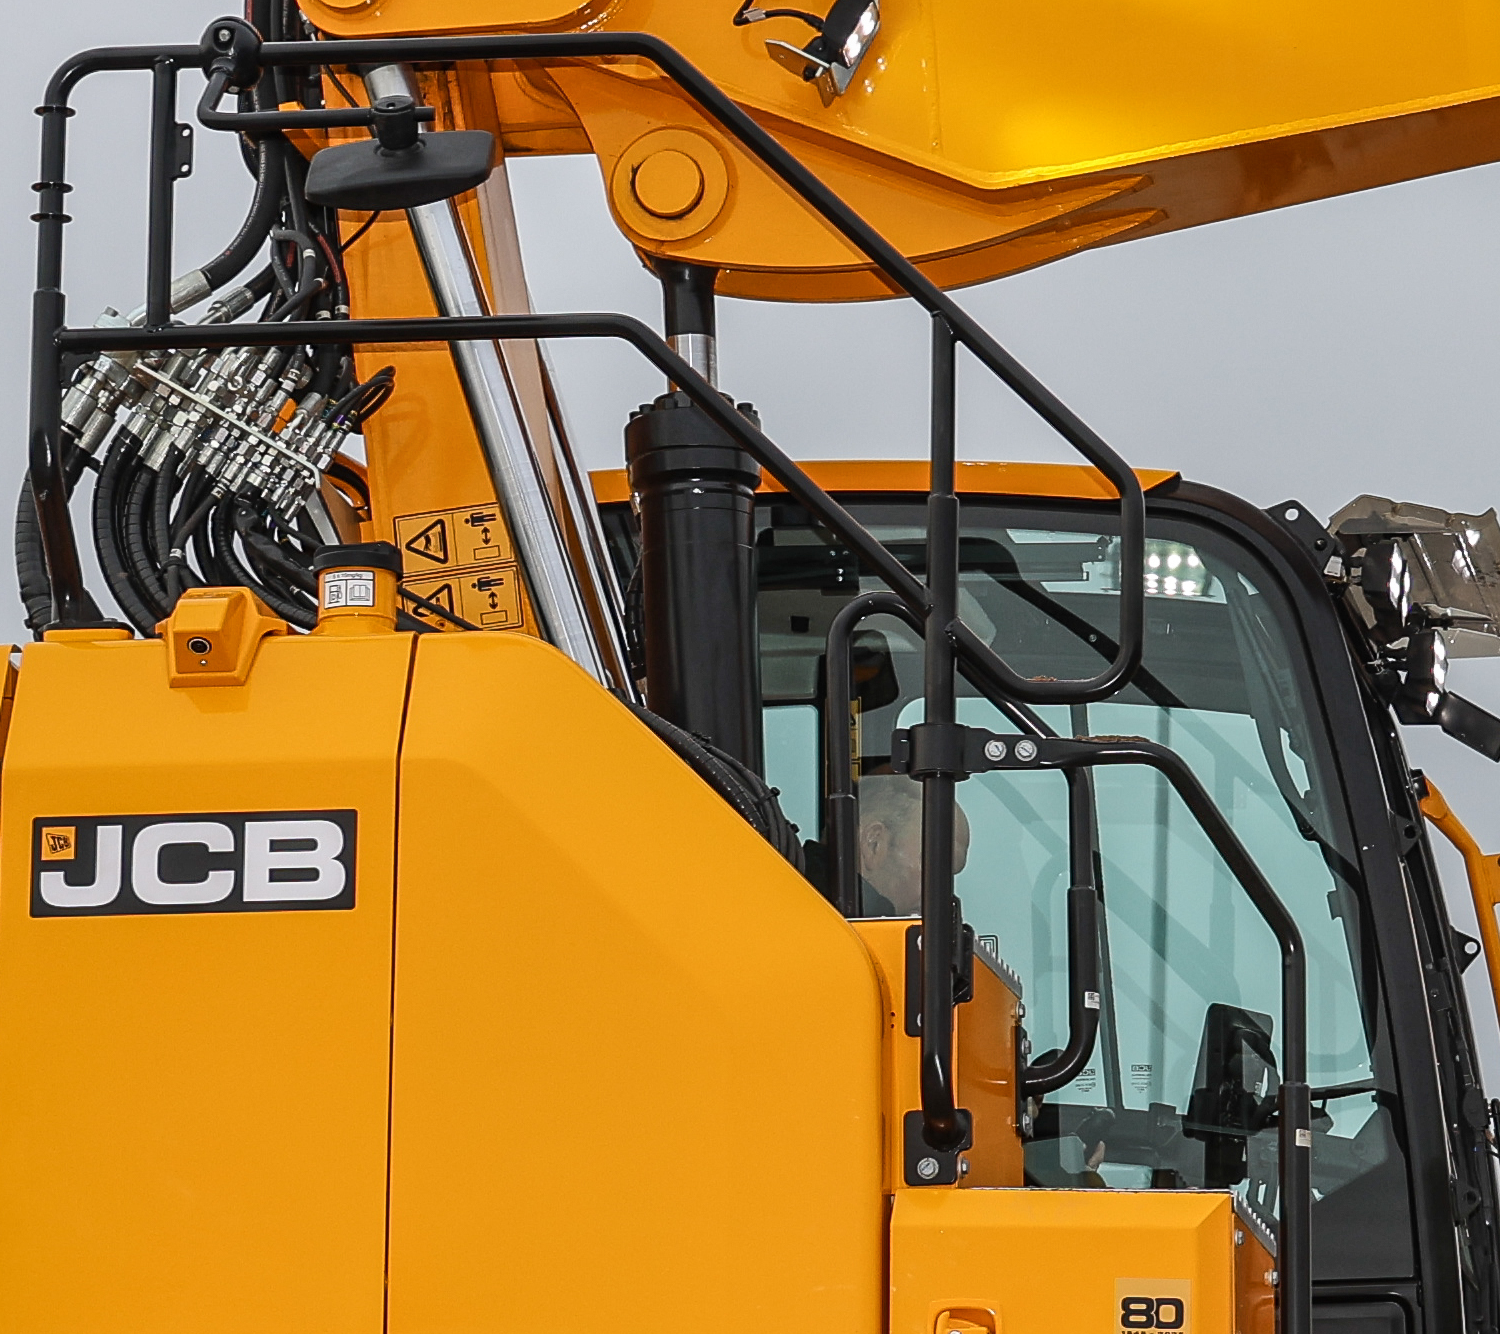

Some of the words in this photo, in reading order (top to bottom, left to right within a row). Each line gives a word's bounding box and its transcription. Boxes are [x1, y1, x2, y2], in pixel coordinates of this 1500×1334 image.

[50, 834, 71, 853] JCB
[40, 820, 346, 907] JCB
[1121, 1297, 1184, 1329] 80
